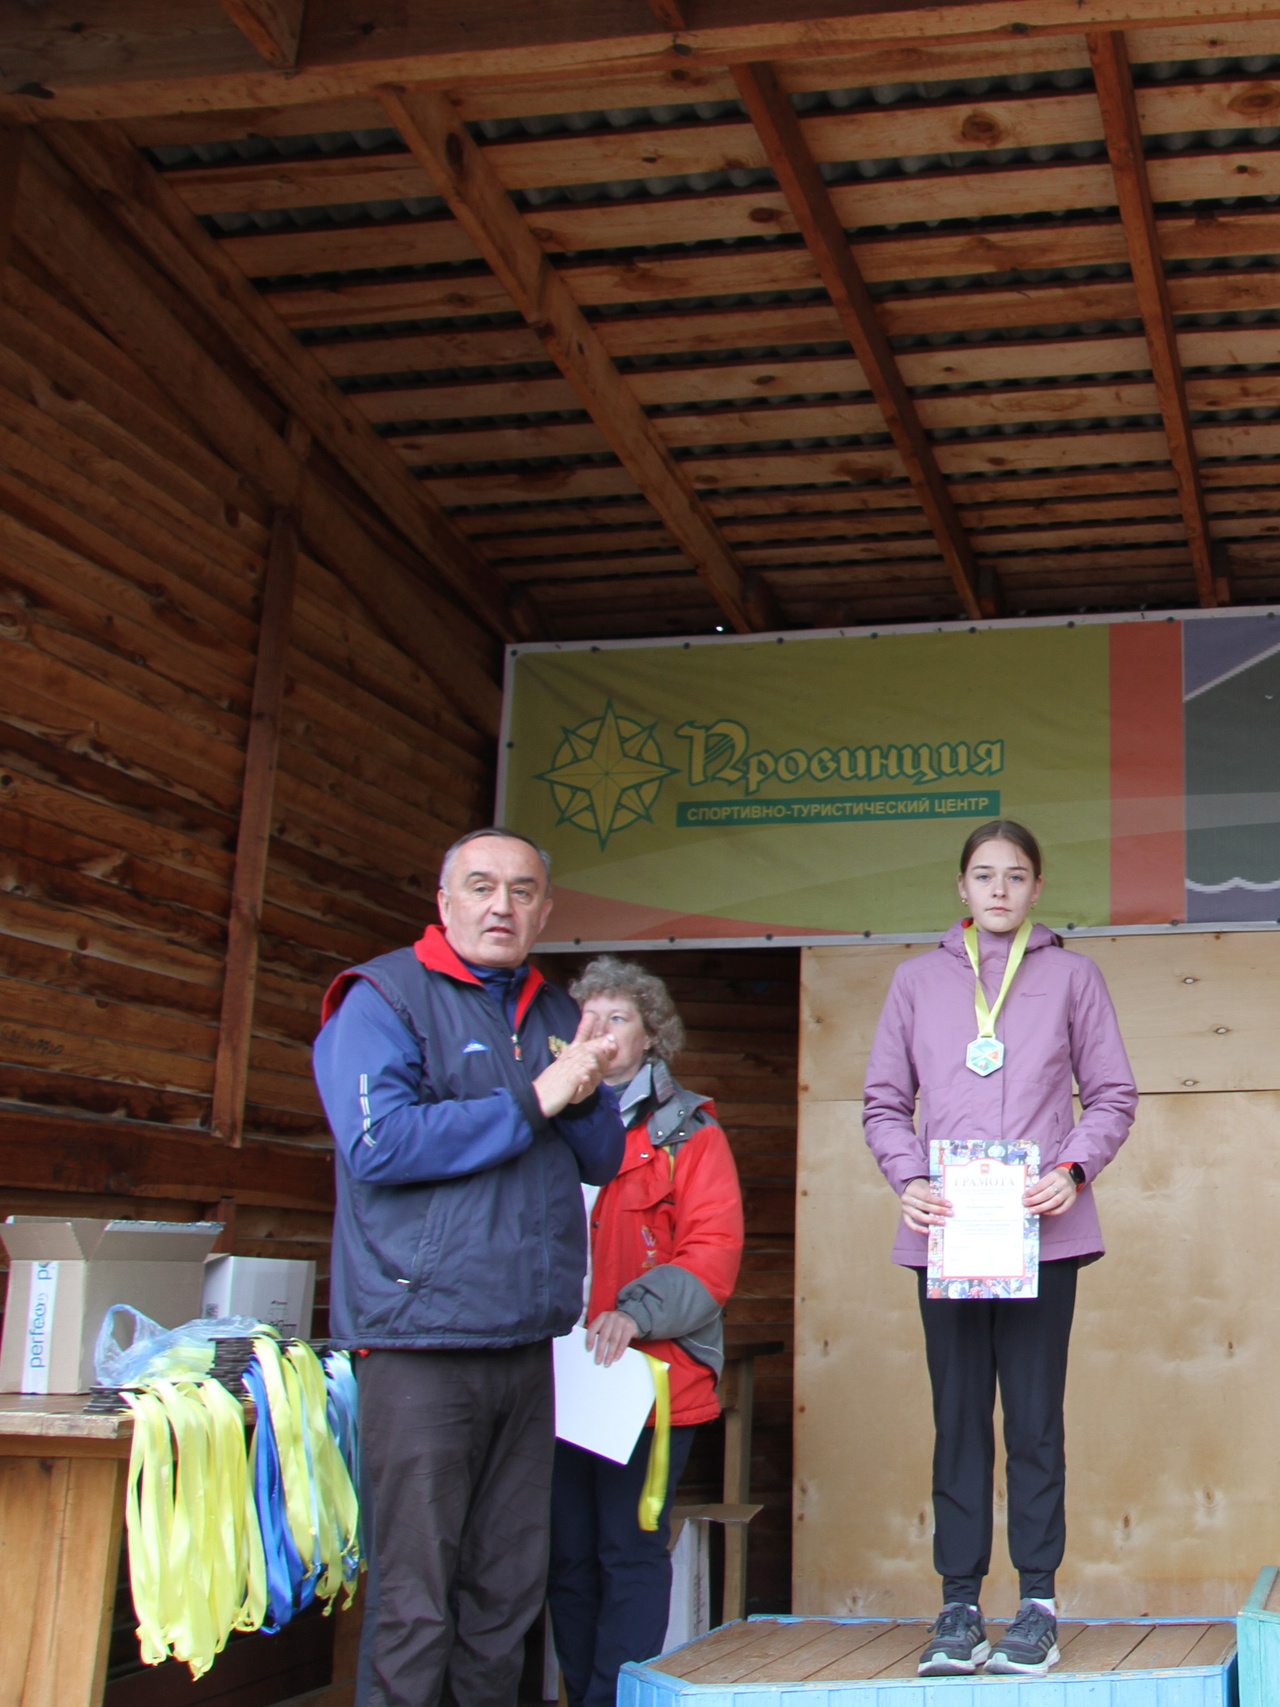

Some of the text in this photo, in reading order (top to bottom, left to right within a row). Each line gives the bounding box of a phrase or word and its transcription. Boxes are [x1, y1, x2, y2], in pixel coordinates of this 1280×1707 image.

[674, 719, 1004, 796] Провинция
[687, 797, 989, 821] СПОРТИВНО-ТУРИСТИЧЕСКИЙ ЦЕНТР
[954, 1176, 1015, 1187] ГРАМОТА
